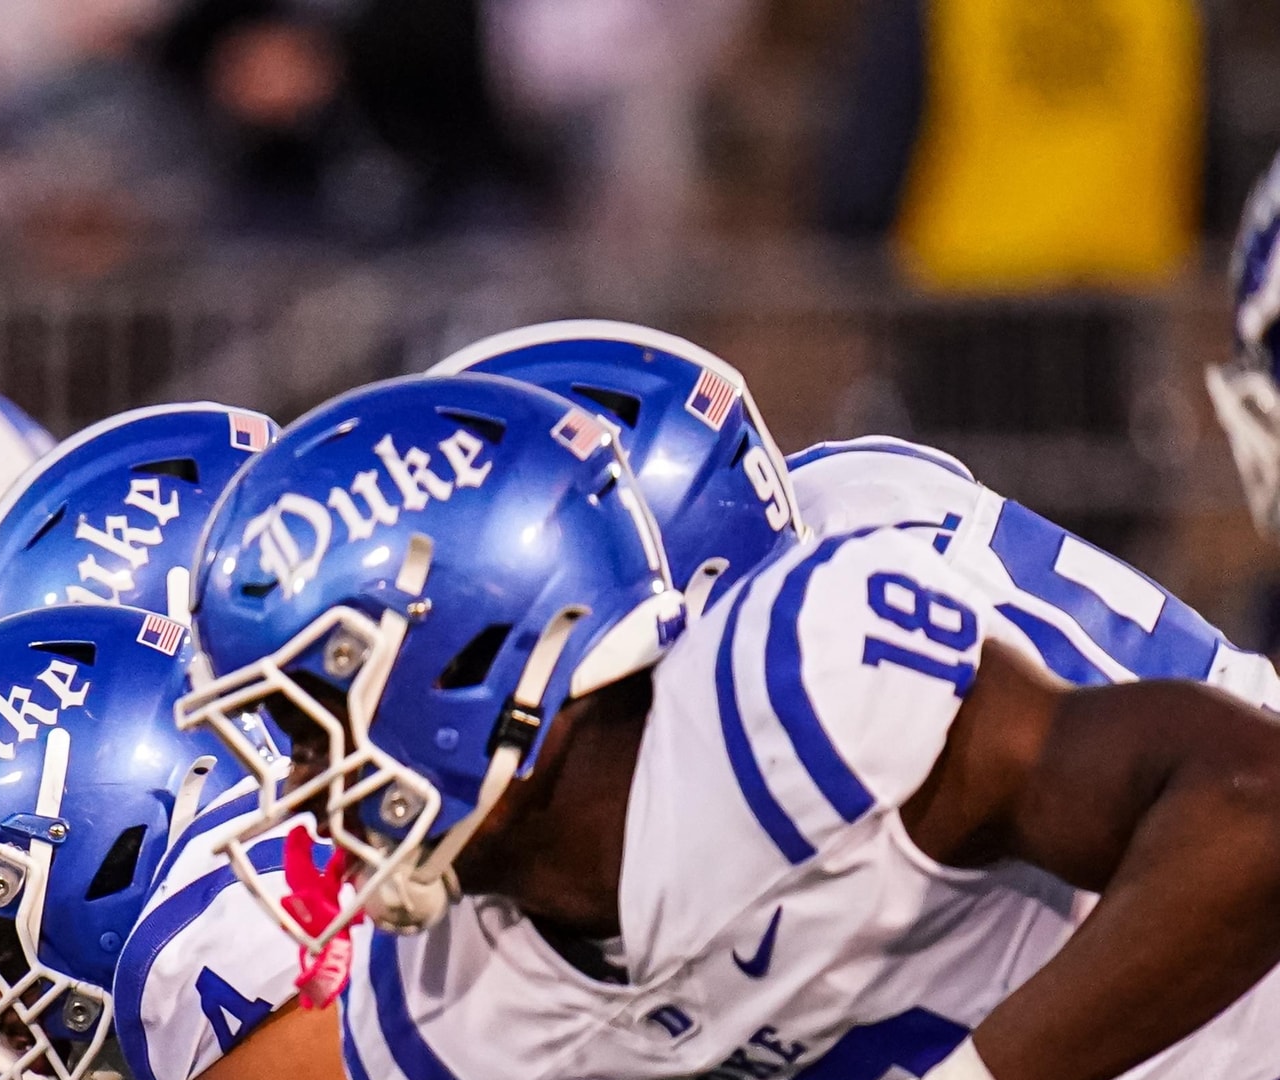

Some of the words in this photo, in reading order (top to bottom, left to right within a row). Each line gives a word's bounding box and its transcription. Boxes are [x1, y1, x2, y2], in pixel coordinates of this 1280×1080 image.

[62, 476, 180, 607] uke
[241, 428, 493, 601] Duke
[742, 445, 790, 532] 9
[861, 571, 978, 699] 18
